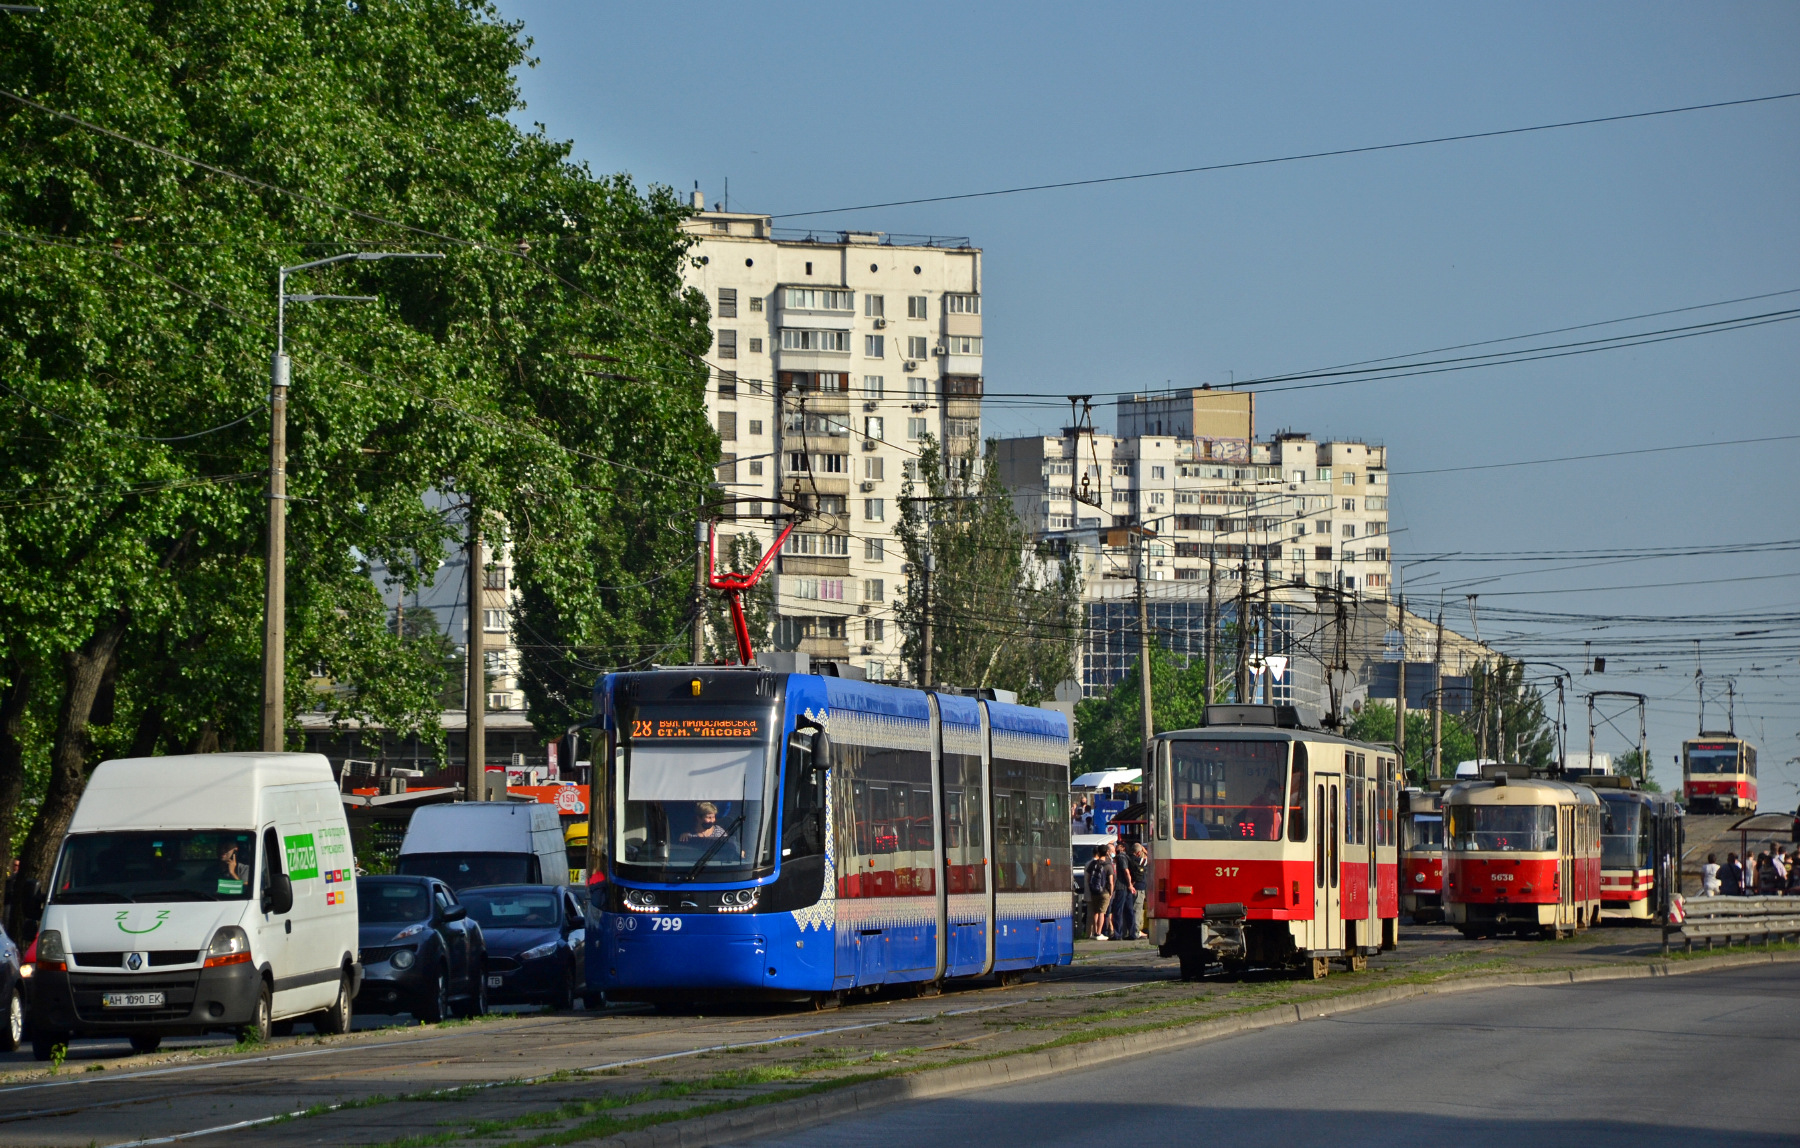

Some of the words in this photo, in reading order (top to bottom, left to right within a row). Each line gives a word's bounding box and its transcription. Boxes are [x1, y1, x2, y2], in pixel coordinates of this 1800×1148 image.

[632, 720, 652, 737] 28
[657, 728, 691, 737] ст.м.
[694, 727, 758, 737] "Лісова"
[562, 794, 575, 803] 150
[1215, 867, 1239, 877] 317
[1491, 874, 1514, 882] 5638
[651, 917, 682, 931] 799
[124, 995, 145, 1005] 1090
